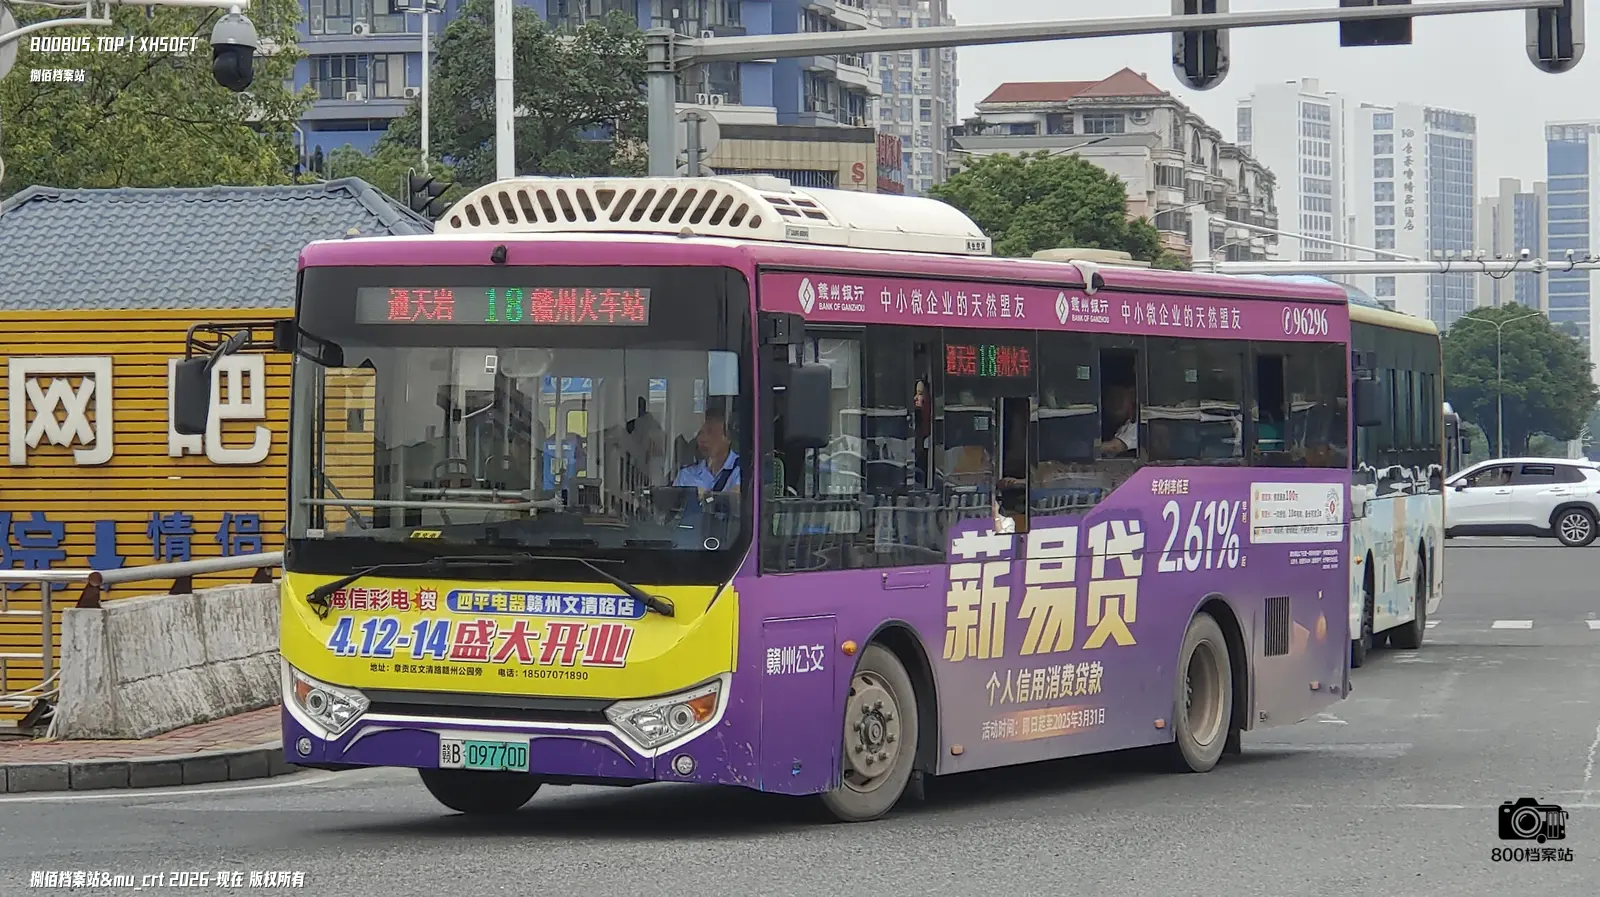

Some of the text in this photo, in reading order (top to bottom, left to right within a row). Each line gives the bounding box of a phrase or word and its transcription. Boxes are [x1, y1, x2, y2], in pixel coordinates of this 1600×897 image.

[387, 287, 646, 323] 通天岩 18 赣州火车站
[817, 282, 865, 301] 赣州银行
[818, 302, 866, 313] BANK OF GANZHOU
[880, 286, 1026, 319] 中小微企业的天然盟友
[1071, 296, 1109, 315] 赣州银行
[1071, 314, 1083, 322] BANK
[1121, 302, 1329, 336] 中小微企业的天然盟友 96296
[945, 343, 977, 377] 通天岩
[979, 343, 997, 377] 18
[8, 353, 272, 465] 网吧
[1151, 479, 1189, 495] 年化利率低至
[146, 511, 263, 562] 情侣
[1158, 499, 1240, 573] 2.61%
[457, 592, 635, 617] 四平电器赣州文清路店
[942, 519, 1145, 662] 薪易贷
[766, 643, 825, 676] 赣州公交
[986, 660, 1104, 707] 个人信用消费贷款
